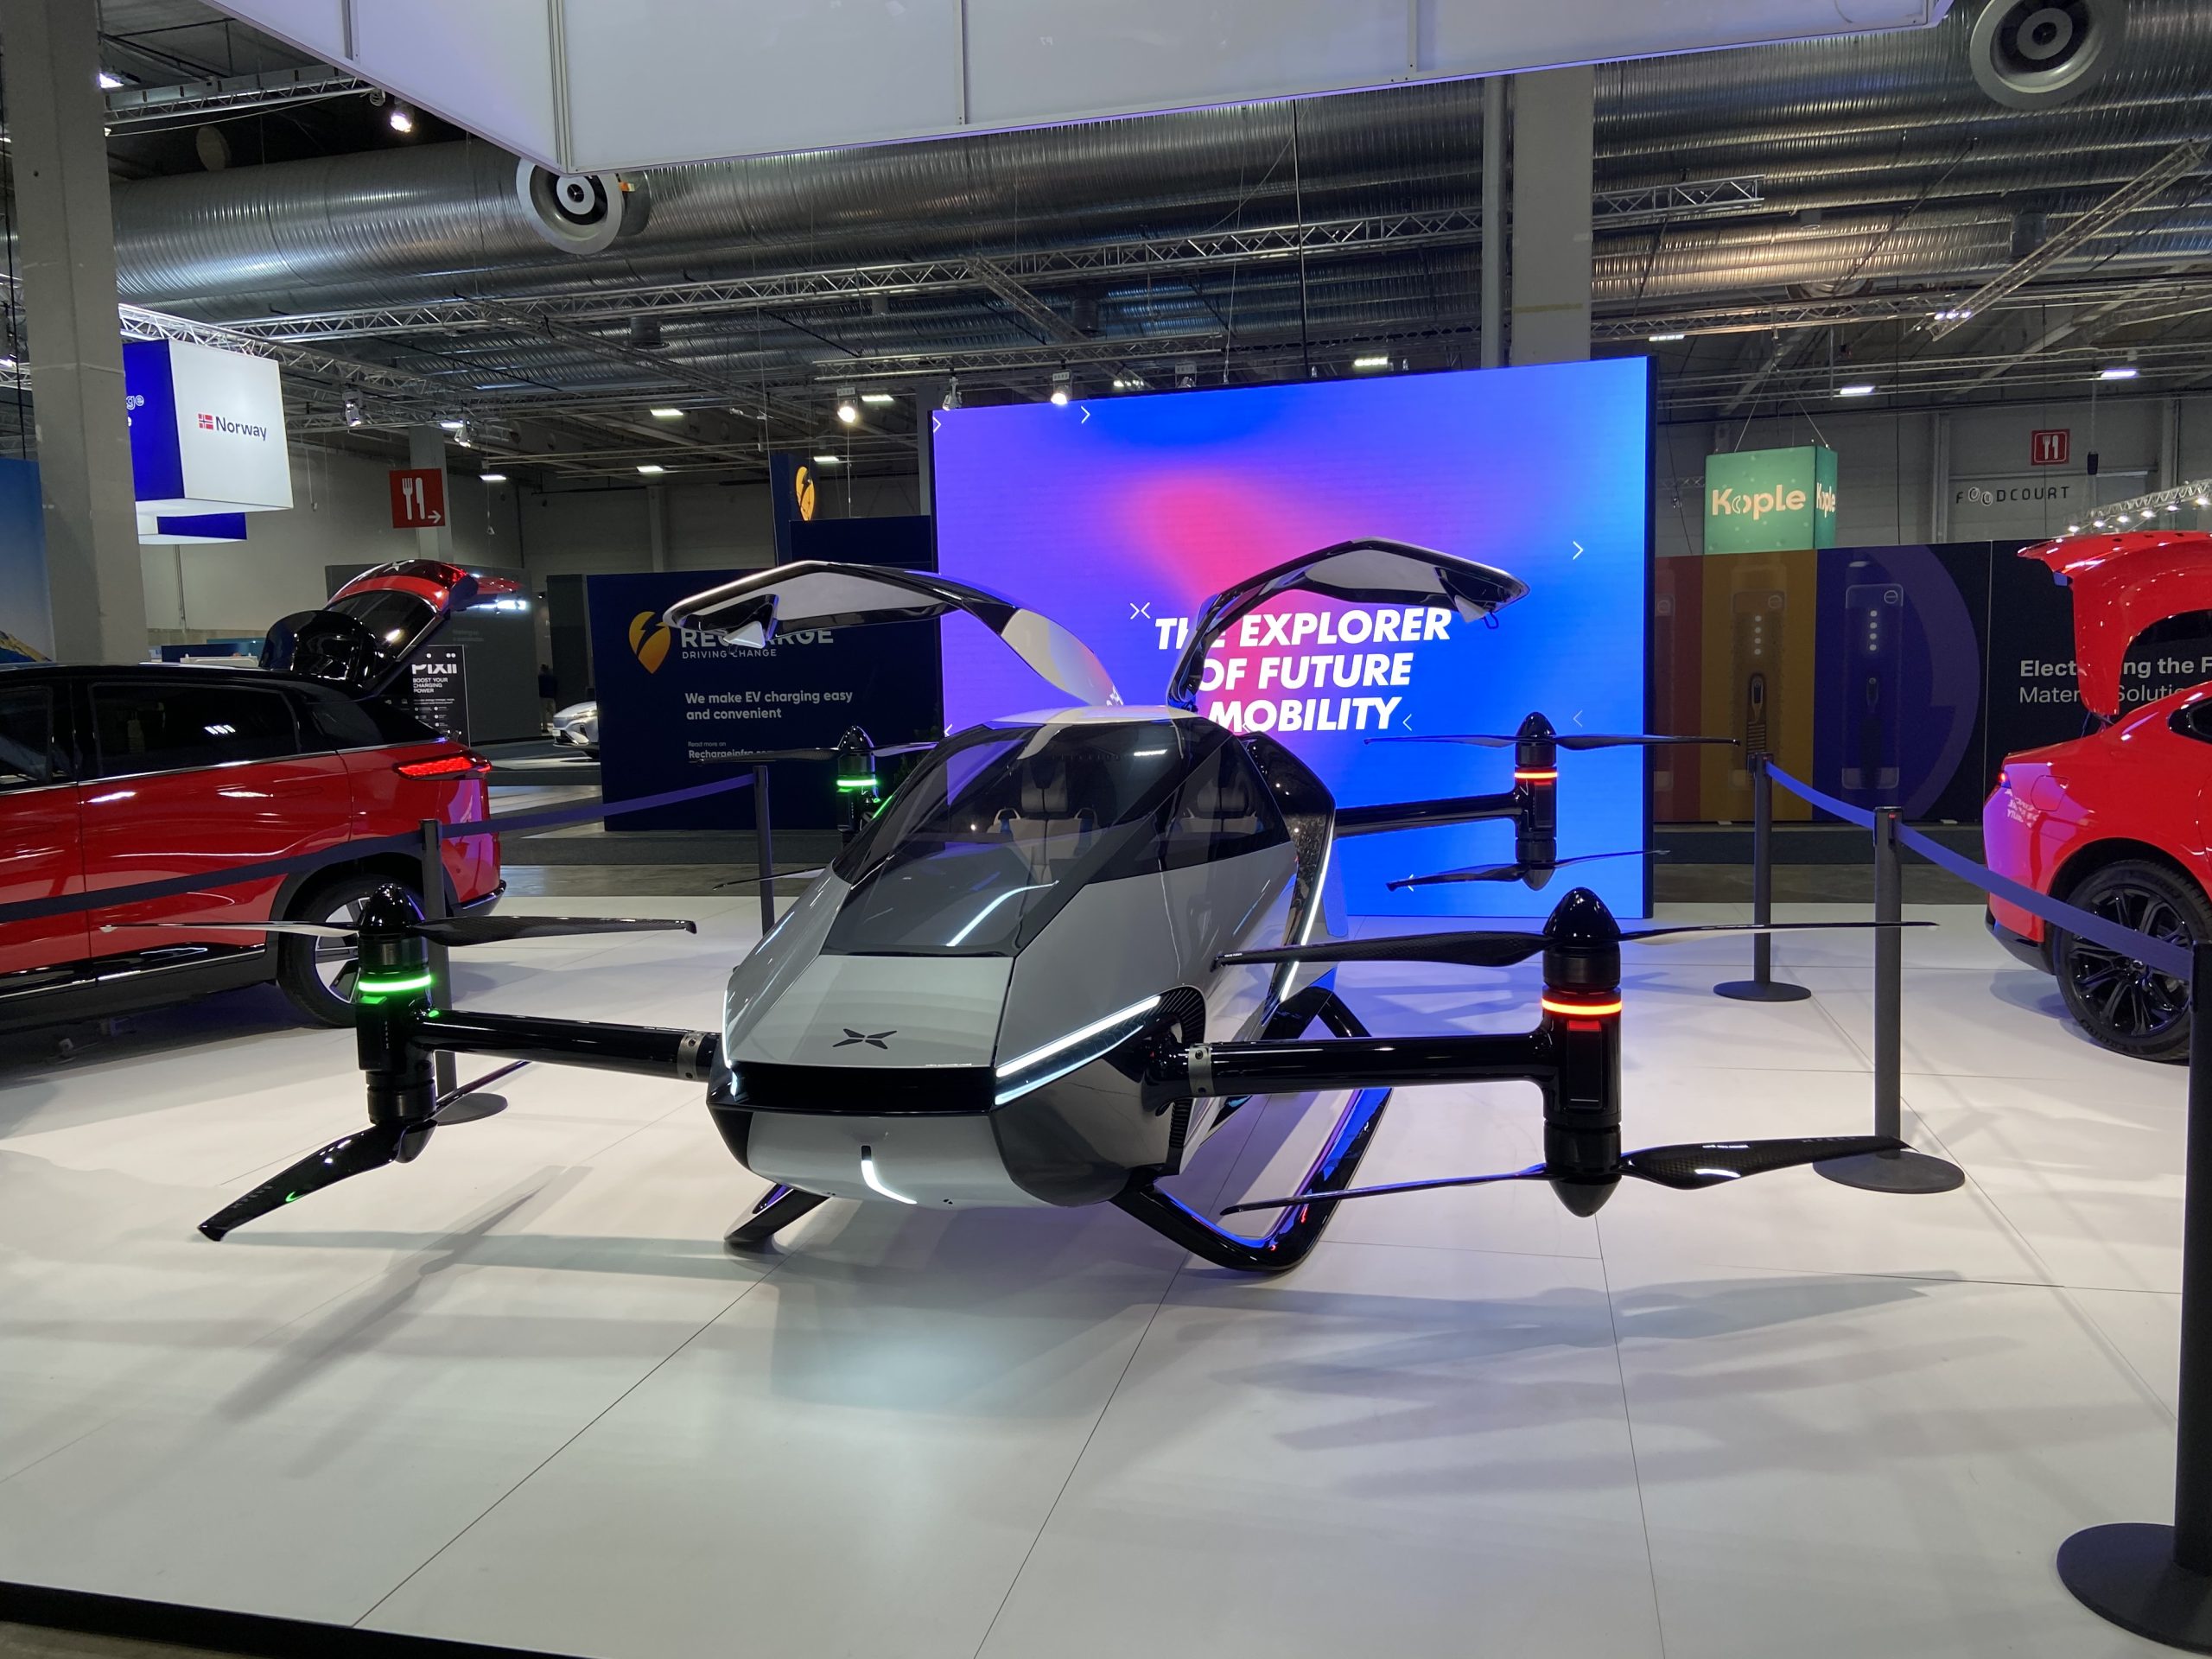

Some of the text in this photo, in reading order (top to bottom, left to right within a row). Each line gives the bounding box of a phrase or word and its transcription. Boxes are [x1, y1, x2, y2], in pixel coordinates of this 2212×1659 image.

[216, 416, 267, 441] Norway
[1712, 484, 1806, 520] Kople
[1816, 482, 1836, 518] Kople
[1956, 486, 2070, 506] FOODCOURT
[1239, 607, 1452, 647] EXPLORER
[682, 648, 777, 659] DRIVING CHANGE
[2158, 657, 2195, 674] the
[1198, 652, 1414, 692] OF FUTURE
[685, 690, 854, 705] We make EV charging easy
[686, 708, 782, 721] and convenient
[1209, 696, 1403, 734] MOBILITY
